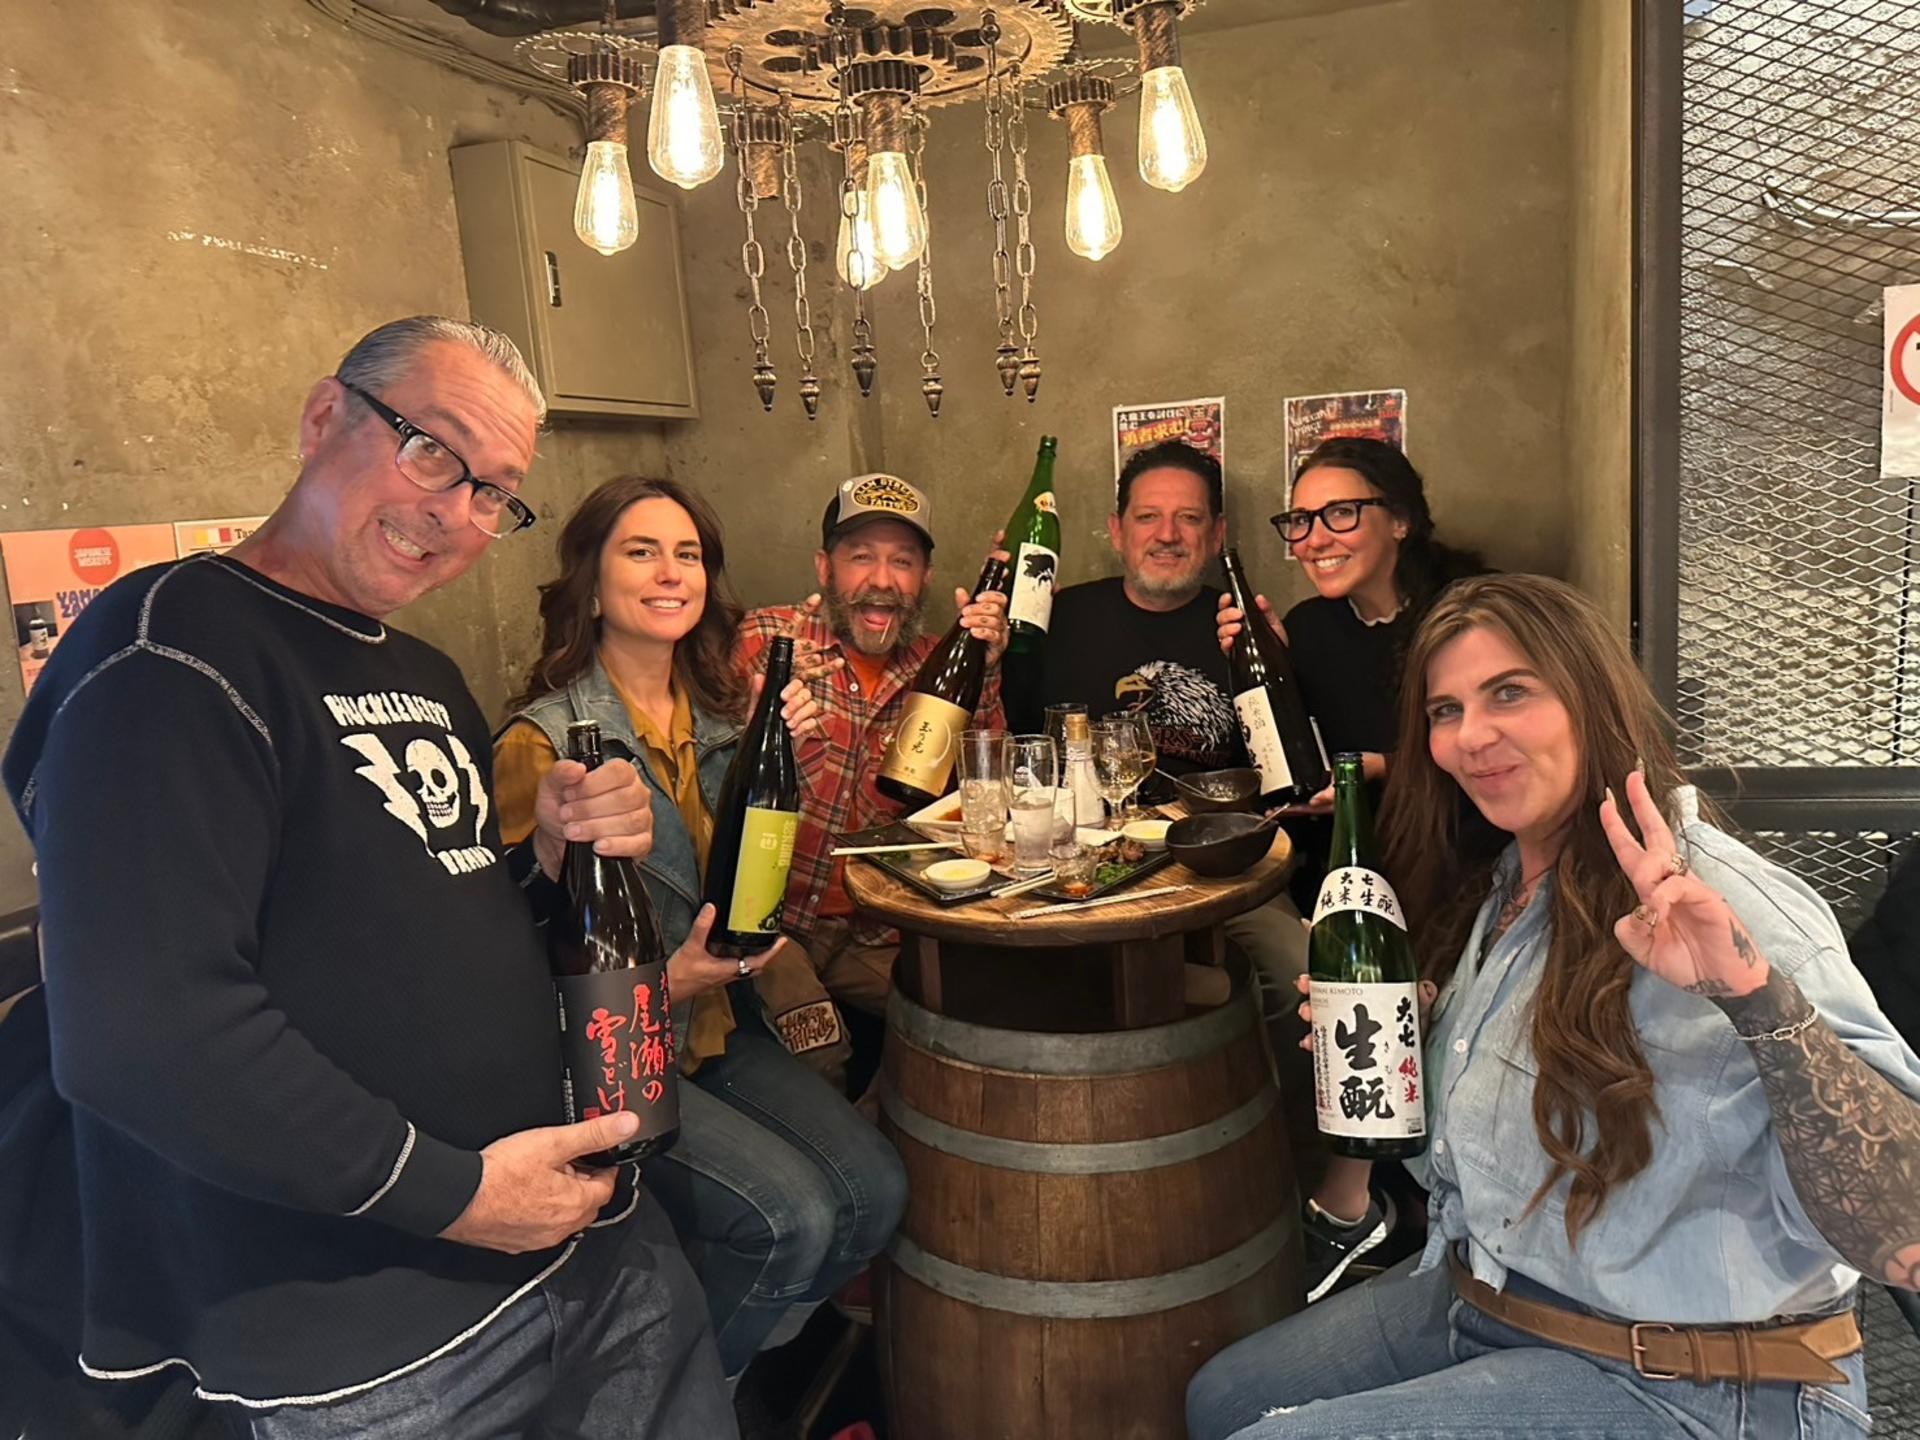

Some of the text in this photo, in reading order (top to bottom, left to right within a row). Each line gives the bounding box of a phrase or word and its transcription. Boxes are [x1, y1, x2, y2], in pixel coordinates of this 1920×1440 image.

[323, 691, 452, 731] HUCKLEBERRY
[1340, 871, 1375, 887] 大七
[1330, 987, 1364, 996] KIMOTO
[1396, 996, 1416, 1048] 大七
